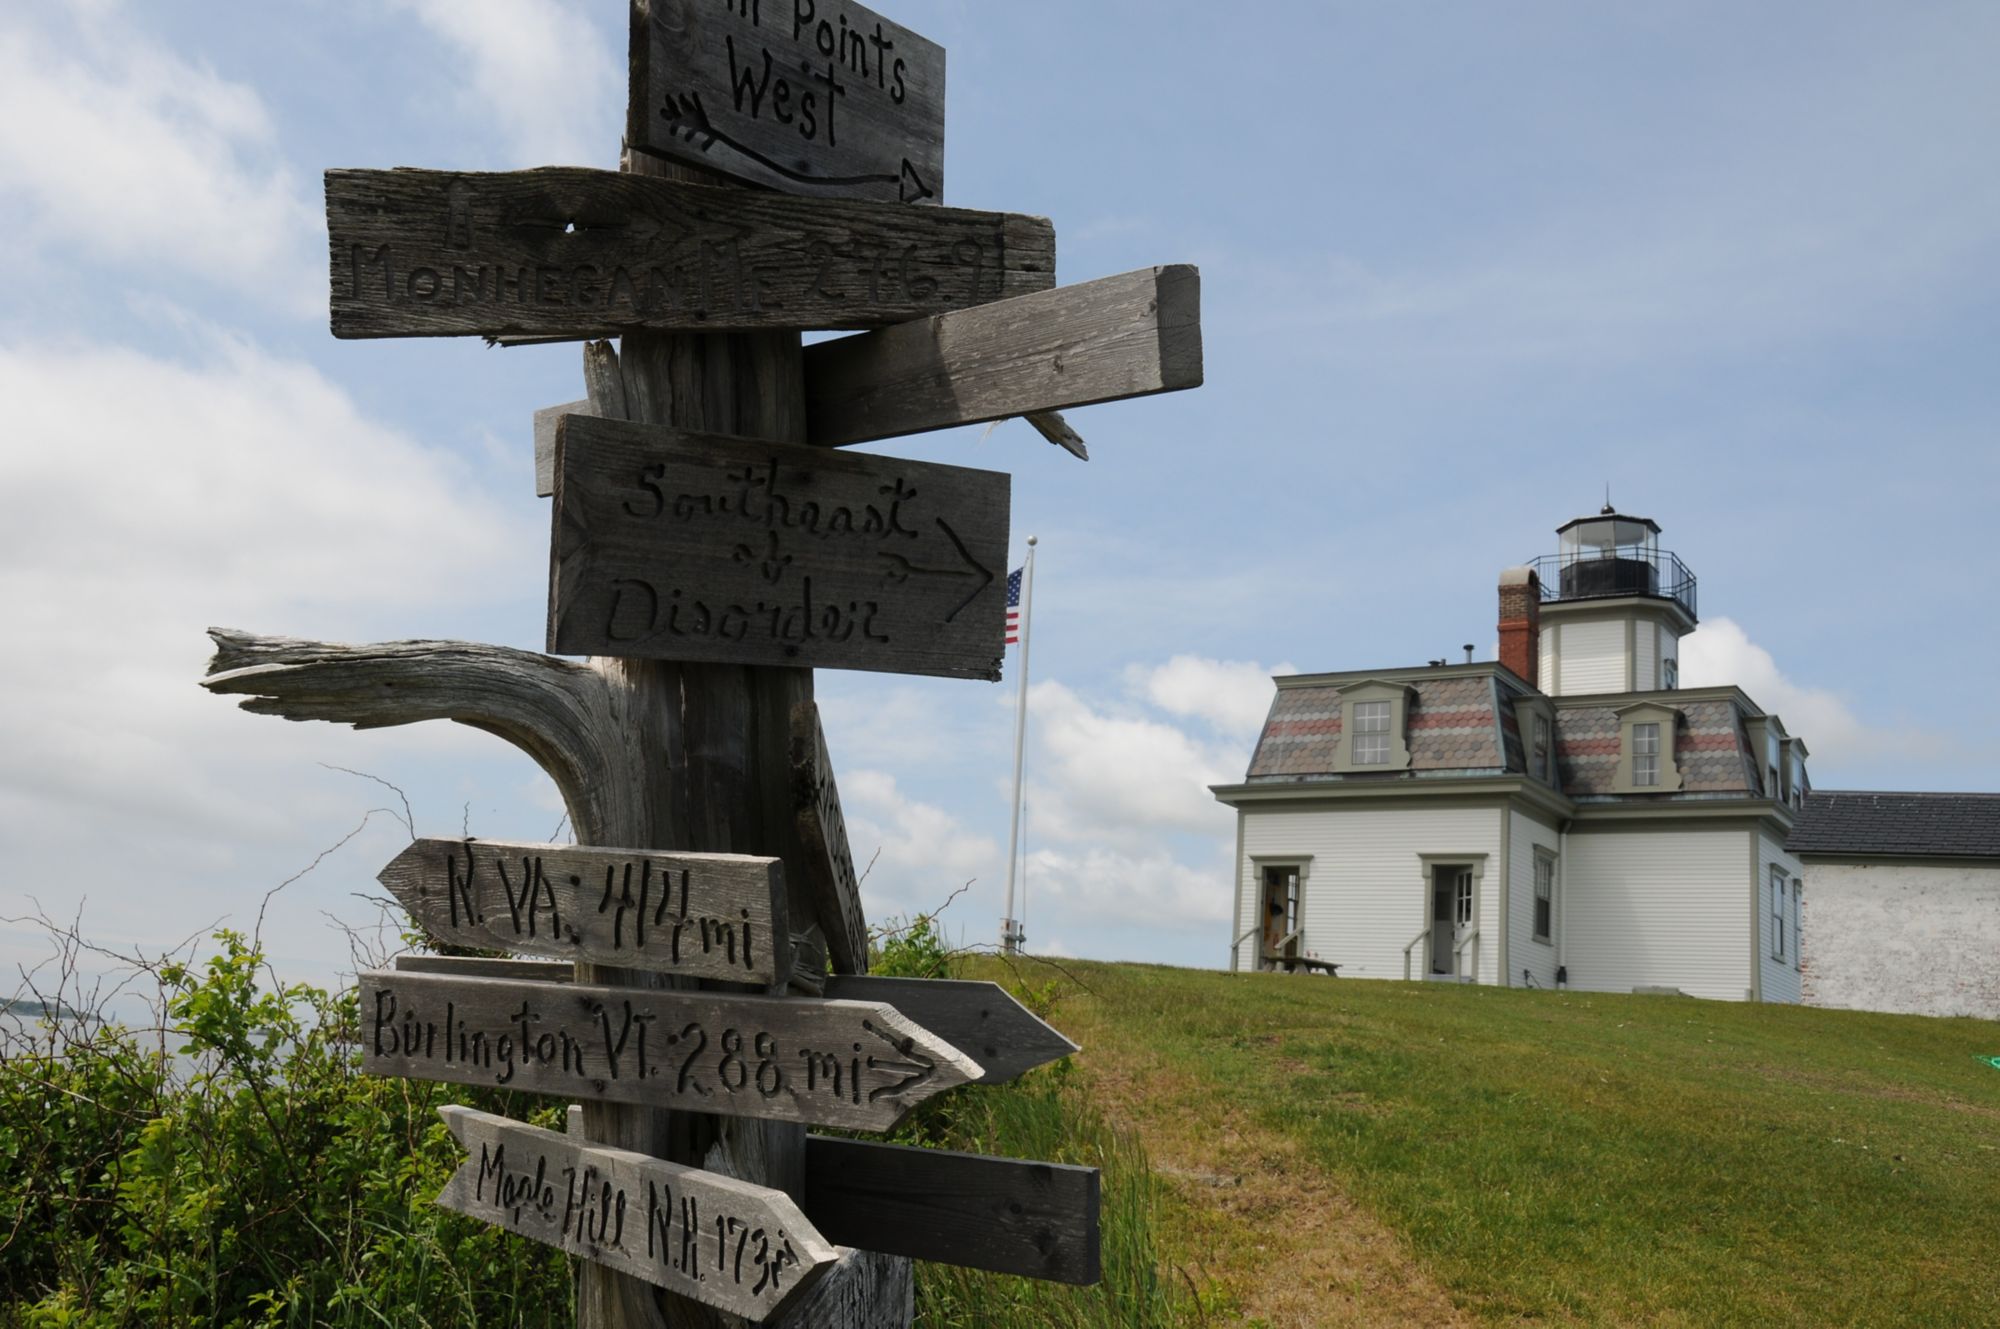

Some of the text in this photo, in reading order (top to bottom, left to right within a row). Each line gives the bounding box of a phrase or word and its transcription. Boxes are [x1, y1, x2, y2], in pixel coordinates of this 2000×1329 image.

[726, 35, 847, 147] West
[793, 0, 906, 104] Points
[622, 457, 918, 540] Southeast
[731, 531, 793, 585] of
[606, 576, 890, 643] Disorder
[700, 908, 753, 970] mi
[374, 989, 586, 1084] Burlington
[676, 1022, 782, 1098] 288
[799, 1042, 862, 1105] mi
[477, 1142, 557, 1226] Maple
[562, 1166, 627, 1252] Hill
[649, 1180, 706, 1282] N.H.
[716, 1214, 769, 1297] 173
